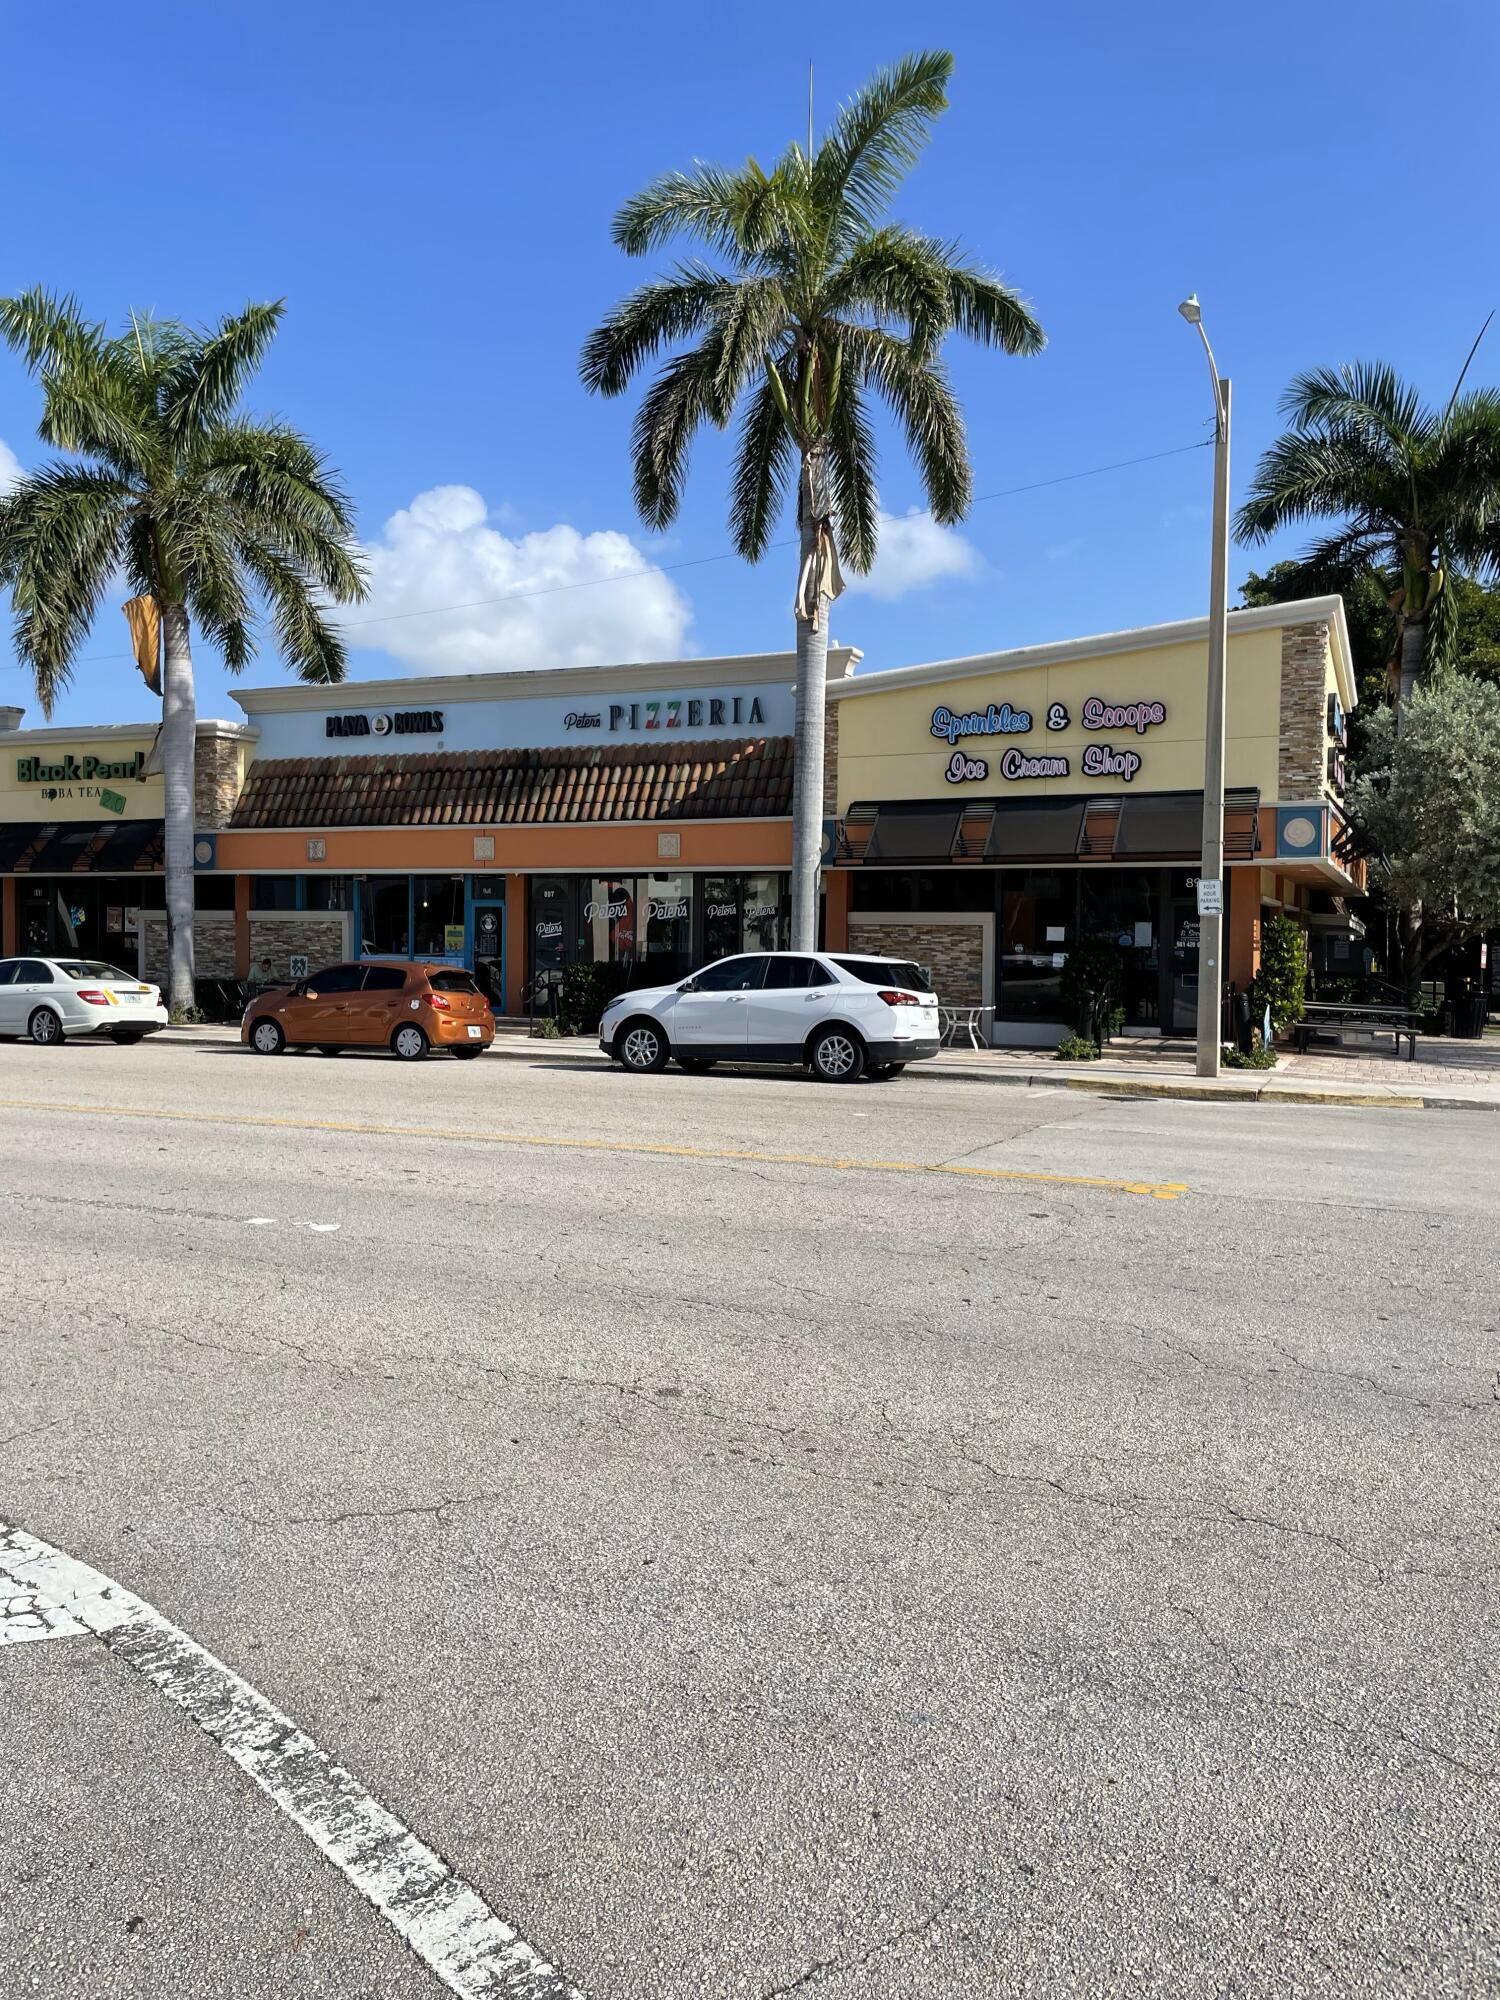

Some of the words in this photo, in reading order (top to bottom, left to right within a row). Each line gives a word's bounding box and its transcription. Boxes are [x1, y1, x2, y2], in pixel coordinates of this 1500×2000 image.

[326, 715, 370, 737] PLAYA
[394, 711, 444, 734] BOWLS
[608, 696, 764, 731] PIZZERIA
[931, 703, 1032, 745] Sprinkles
[1047, 702, 1070, 731] &
[1082, 697, 1166, 734] Scoops
[17, 755, 82, 782] Black
[83, 752, 145, 780] Pearl
[945, 751, 988, 783] Ice
[1001, 748, 1070, 780] Cream
[1082, 744, 1141, 782] Shop
[78, 787, 101, 798] TEA
